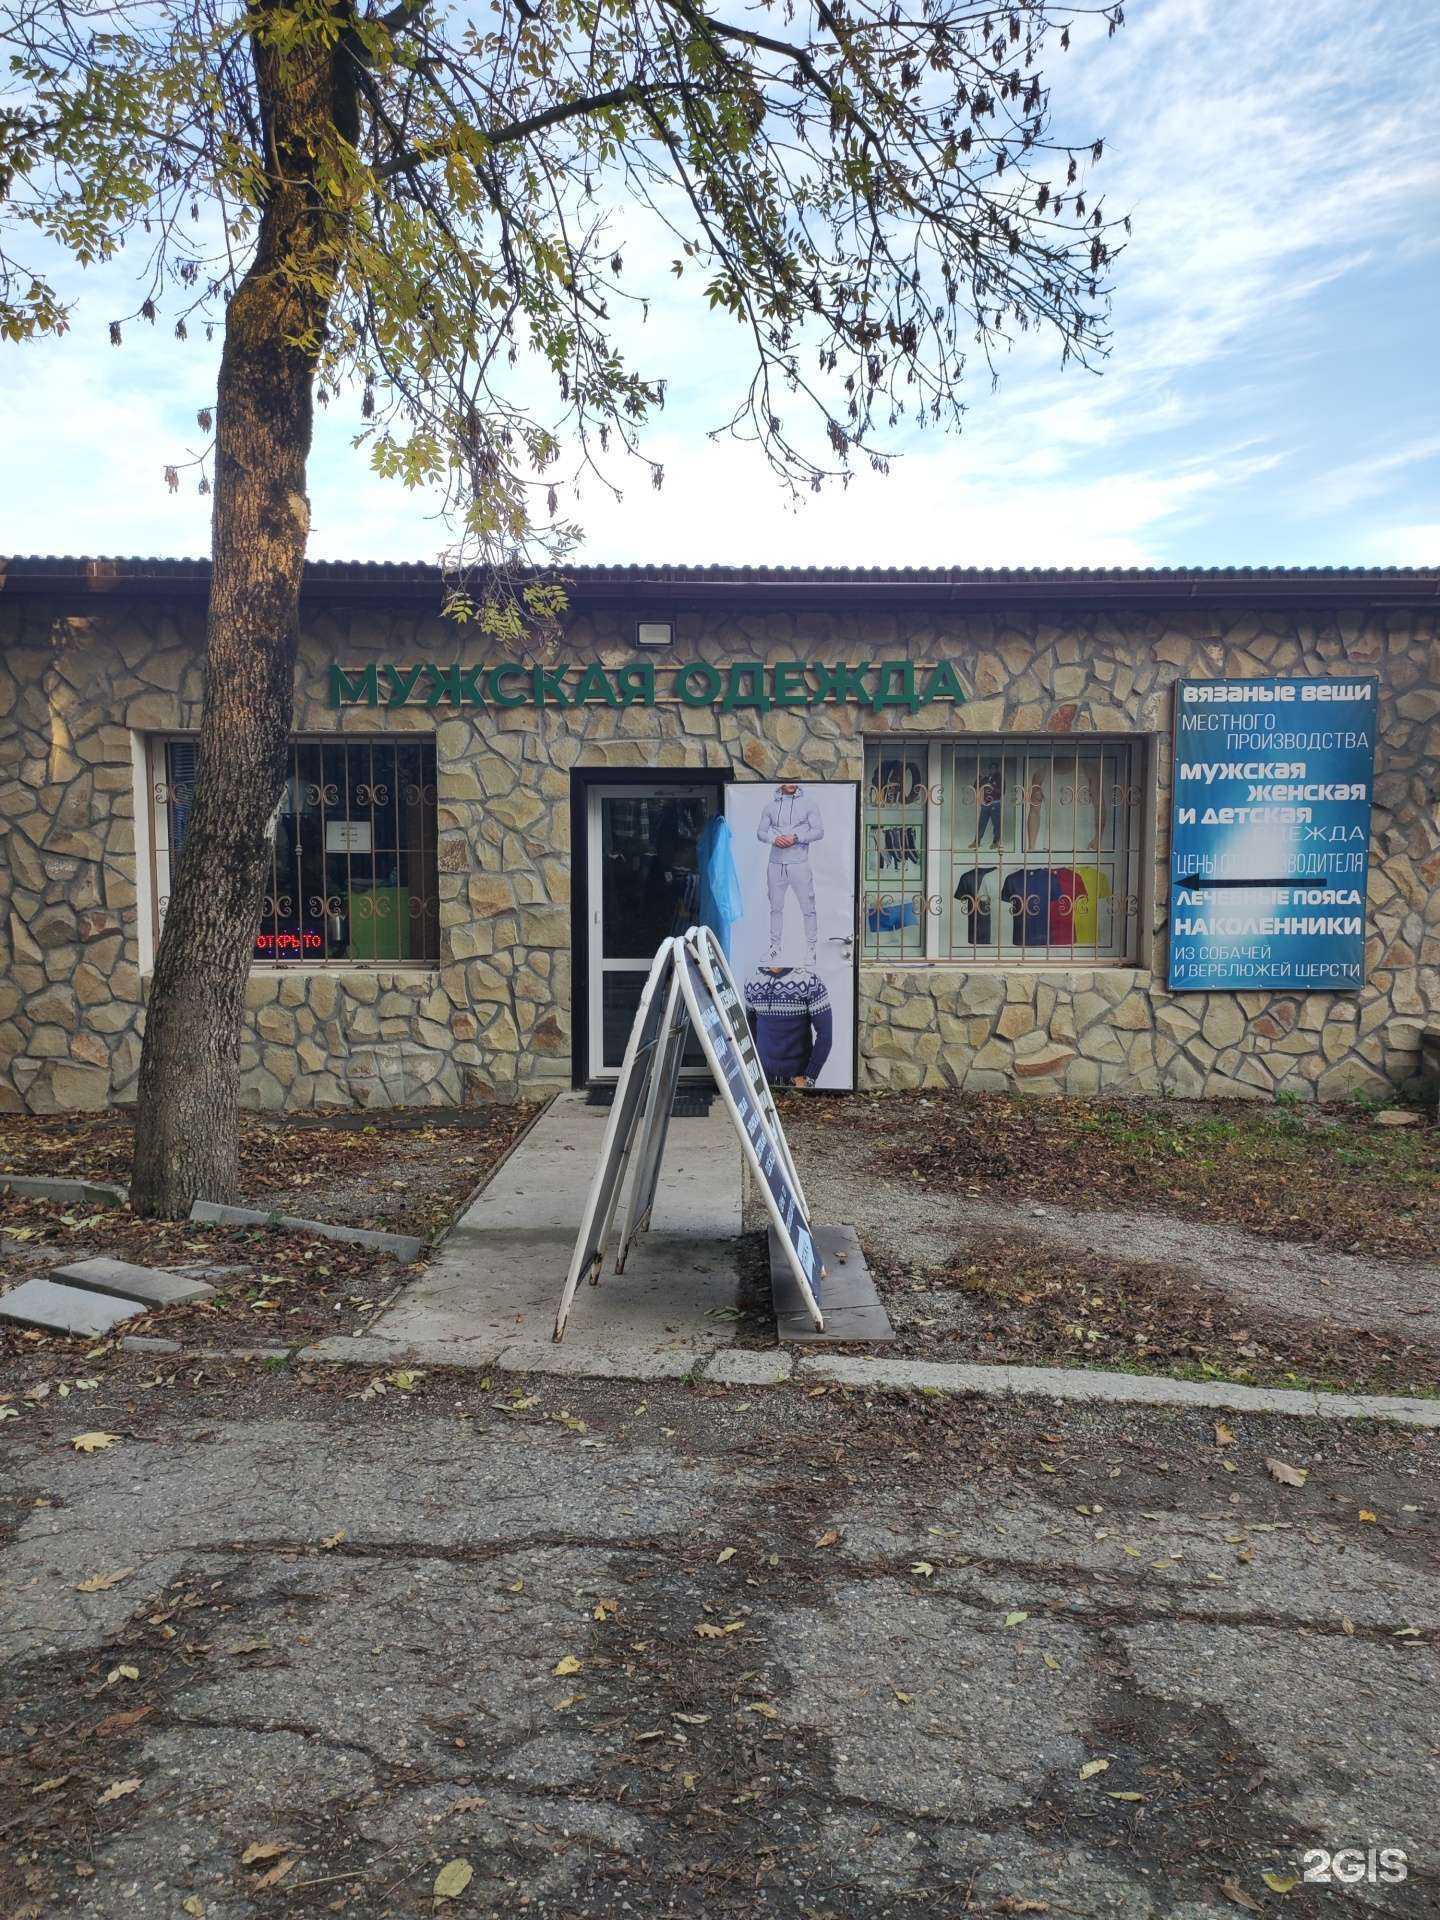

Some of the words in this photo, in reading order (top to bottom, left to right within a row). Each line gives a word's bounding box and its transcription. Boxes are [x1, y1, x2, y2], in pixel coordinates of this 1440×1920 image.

[330, 662, 659, 708] МУЖСКАЯ
[675, 660, 966, 711] ОДЕЖДА
[1182, 713, 1276, 731] МЕСТНОГО
[1227, 732, 1369, 751] ПРОИЗВОДСТВА
[1176, 853, 1217, 876] ЦЕНЫ
[1293, 889, 1362, 905] ПОЯСА
[1175, 916, 1361, 936] НАКОЛЕННИКИ
[1175, 946, 1195, 960] ИЗ
[1199, 944, 1271, 960] СОБАЧЕЙ
[1174, 964, 1185, 977] И
[1188, 962, 1291, 977] ВЕРБЛЮЖЕЙ
[1295, 963, 1361, 977] ШЕРСТИ
